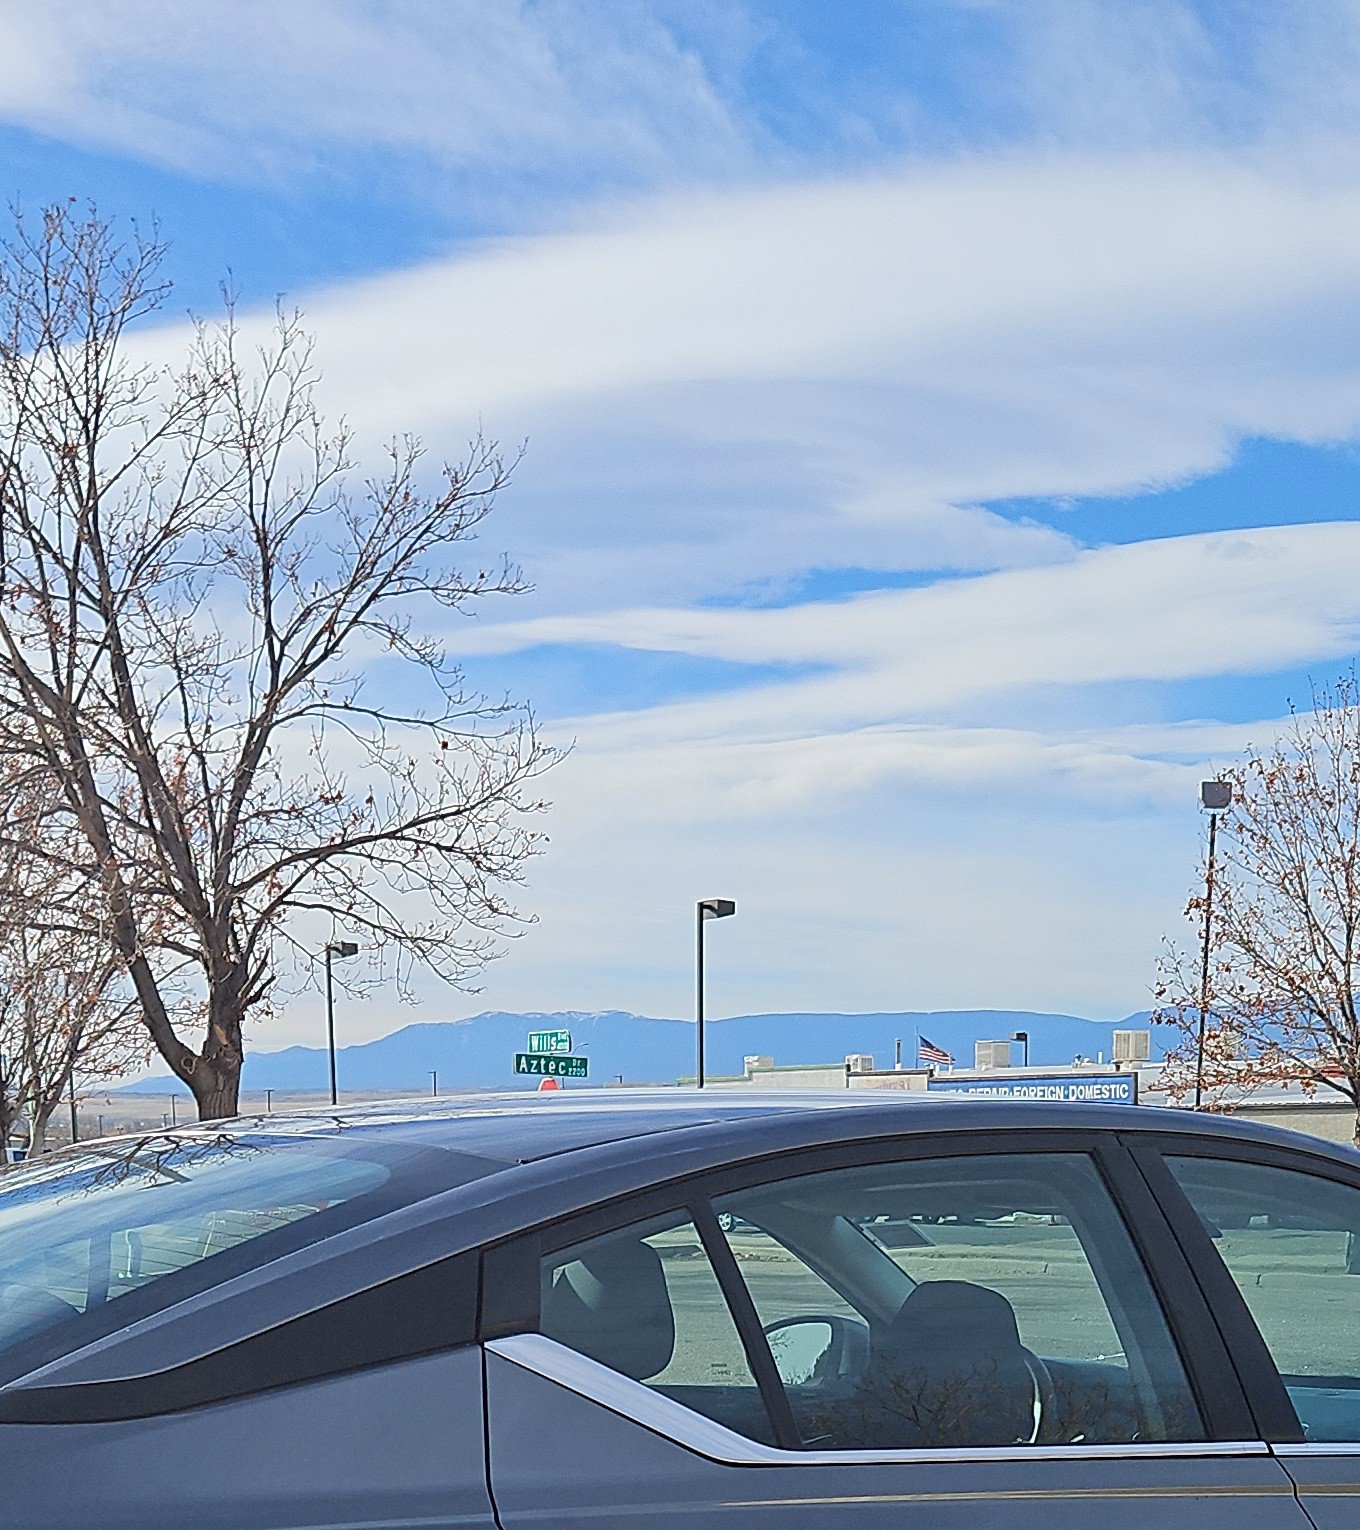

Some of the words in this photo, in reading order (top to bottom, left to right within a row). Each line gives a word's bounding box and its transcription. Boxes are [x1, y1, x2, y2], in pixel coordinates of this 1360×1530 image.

[531, 1034, 557, 1051] Wills
[519, 1055, 566, 1075] Aztec
[1068, 1083, 1129, 1100] DOMESTIC
